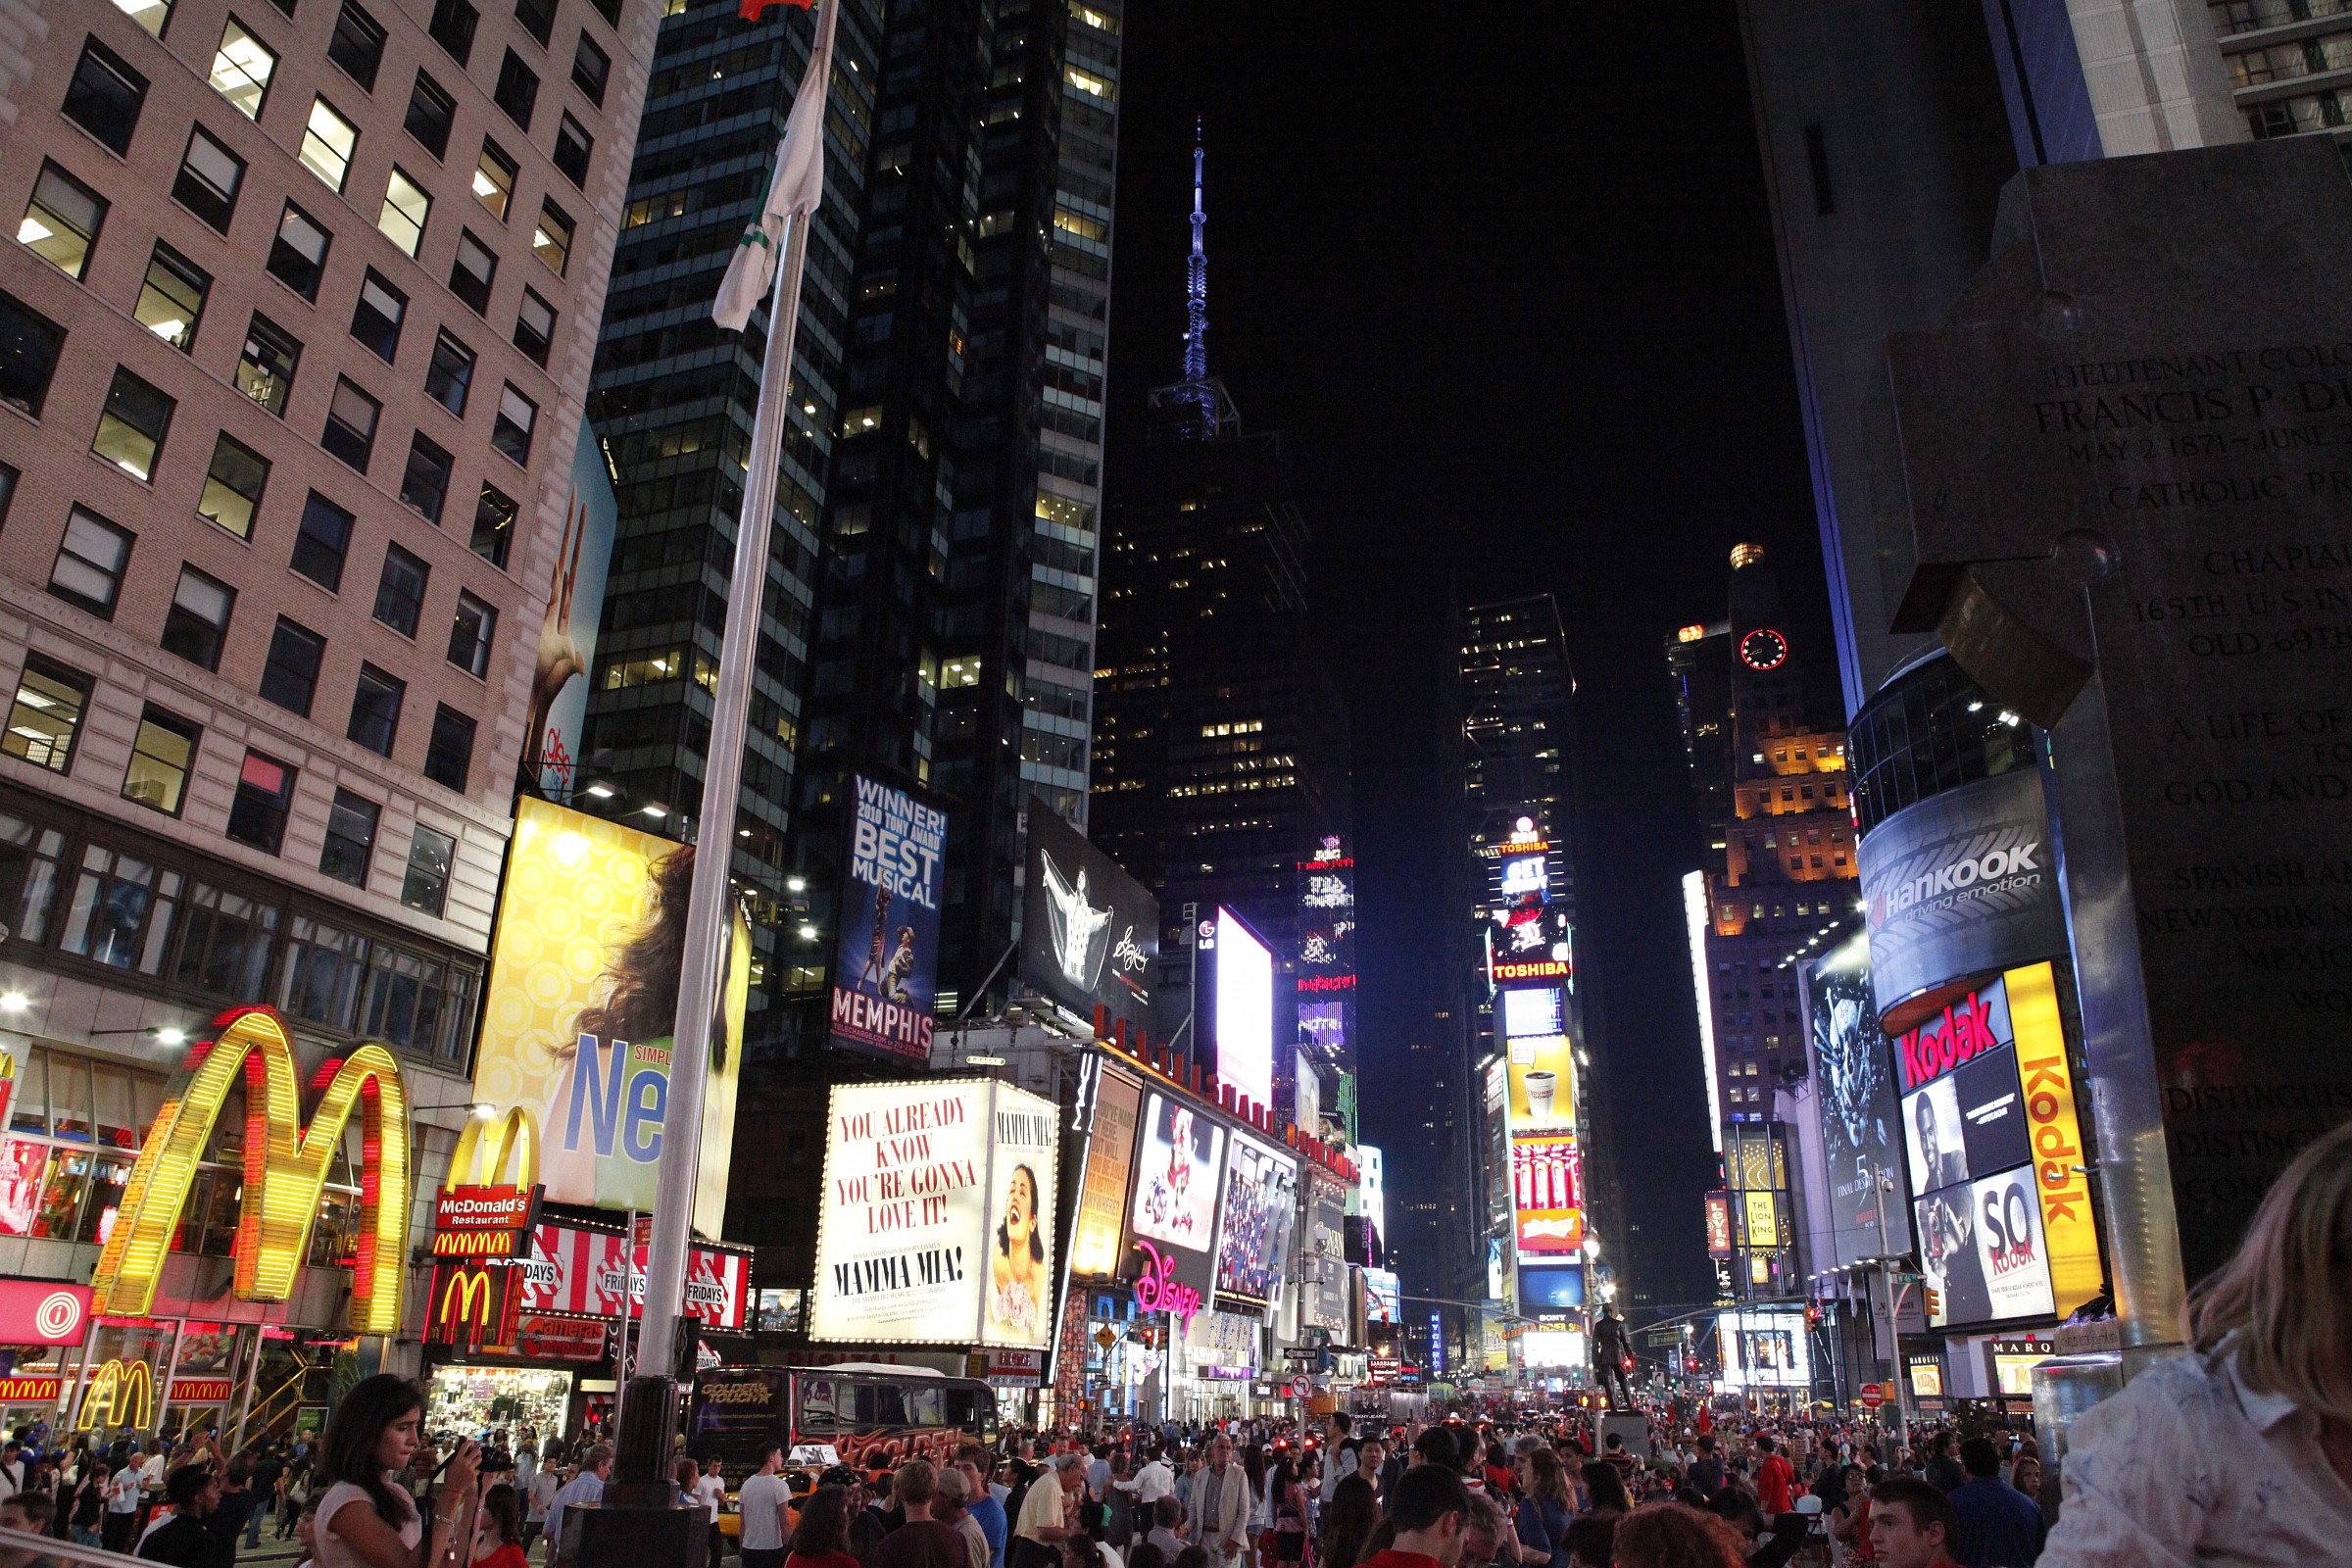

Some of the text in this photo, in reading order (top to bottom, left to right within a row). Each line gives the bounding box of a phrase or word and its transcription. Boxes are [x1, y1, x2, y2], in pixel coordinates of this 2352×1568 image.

[2051, 351, 2246, 389] LIEUTENANT
[2034, 388, 2233, 434] FRANCIS
[2068, 440, 2128, 466] MAY
[2139, 438, 2156, 459] 2
[2108, 474, 2287, 511] CATHOLIC
[2188, 631, 2262, 658] OLD
[2169, 708, 2344, 743] A LIFE OF
[2165, 772, 2349, 806] GOD AND
[856, 774, 947, 837] WINNER!
[858, 801, 942, 852] 2010 TONY AWARD
[854, 817, 939, 886] BEST
[1499, 841, 1549, 854] TOSHIBA
[852, 856, 936, 909] MUSICAL
[2174, 861, 2307, 891] SPANISH
[1904, 873, 2041, 923] driving emotion
[2139, 906, 2213, 934] NEW
[2224, 904, 2318, 931] YORK
[1199, 939, 1214, 950] LG
[1494, 961, 1568, 979] TOSHIBA
[832, 985, 934, 1049] MEMPHIS
[1900, 991, 1998, 1089] Kodak
[841, 1095, 967, 1143] YOU ALREADY
[997, 1111, 1052, 1147] MAMMA MIA!
[1095, 1120, 1102, 1134] IT
[1118, 1105, 1134, 1129] MADE
[876, 1133, 933, 1169] KNOW
[1091, 1136, 1119, 1161] BUT WILL
[2023, 1054, 2085, 1227] Kodak
[837, 1158, 978, 1206] YOU'RE GONNA
[1090, 1154, 1126, 1179] YOU BE ABLE
[1087, 1172, 1116, 1198] TO RETIRE
[1838, 1182, 1853, 1198] FINAL
[439, 1197, 526, 1214] McDonald's
[867, 1194, 949, 1235] LOVE IT!
[1084, 1191, 1120, 1216] ANYWHERE?
[1751, 1211, 1771, 1224] LION
[452, 1215, 510, 1225] Restaurant
[1752, 1225, 1774, 1239] KING
[1982, 1182, 2034, 1260] SO
[1316, 1221, 1345, 1257] ONAN
[833, 1246, 963, 1298] MAMMA MIA!
[1990, 1236, 2036, 1276] Kodak
[1910, 1355, 1940, 1365] MARQUIS
[1993, 1342, 2052, 1354] MARQ
[701, 1382, 765, 1395] GOLDEN
[709, 1392, 760, 1404] TOUCH
